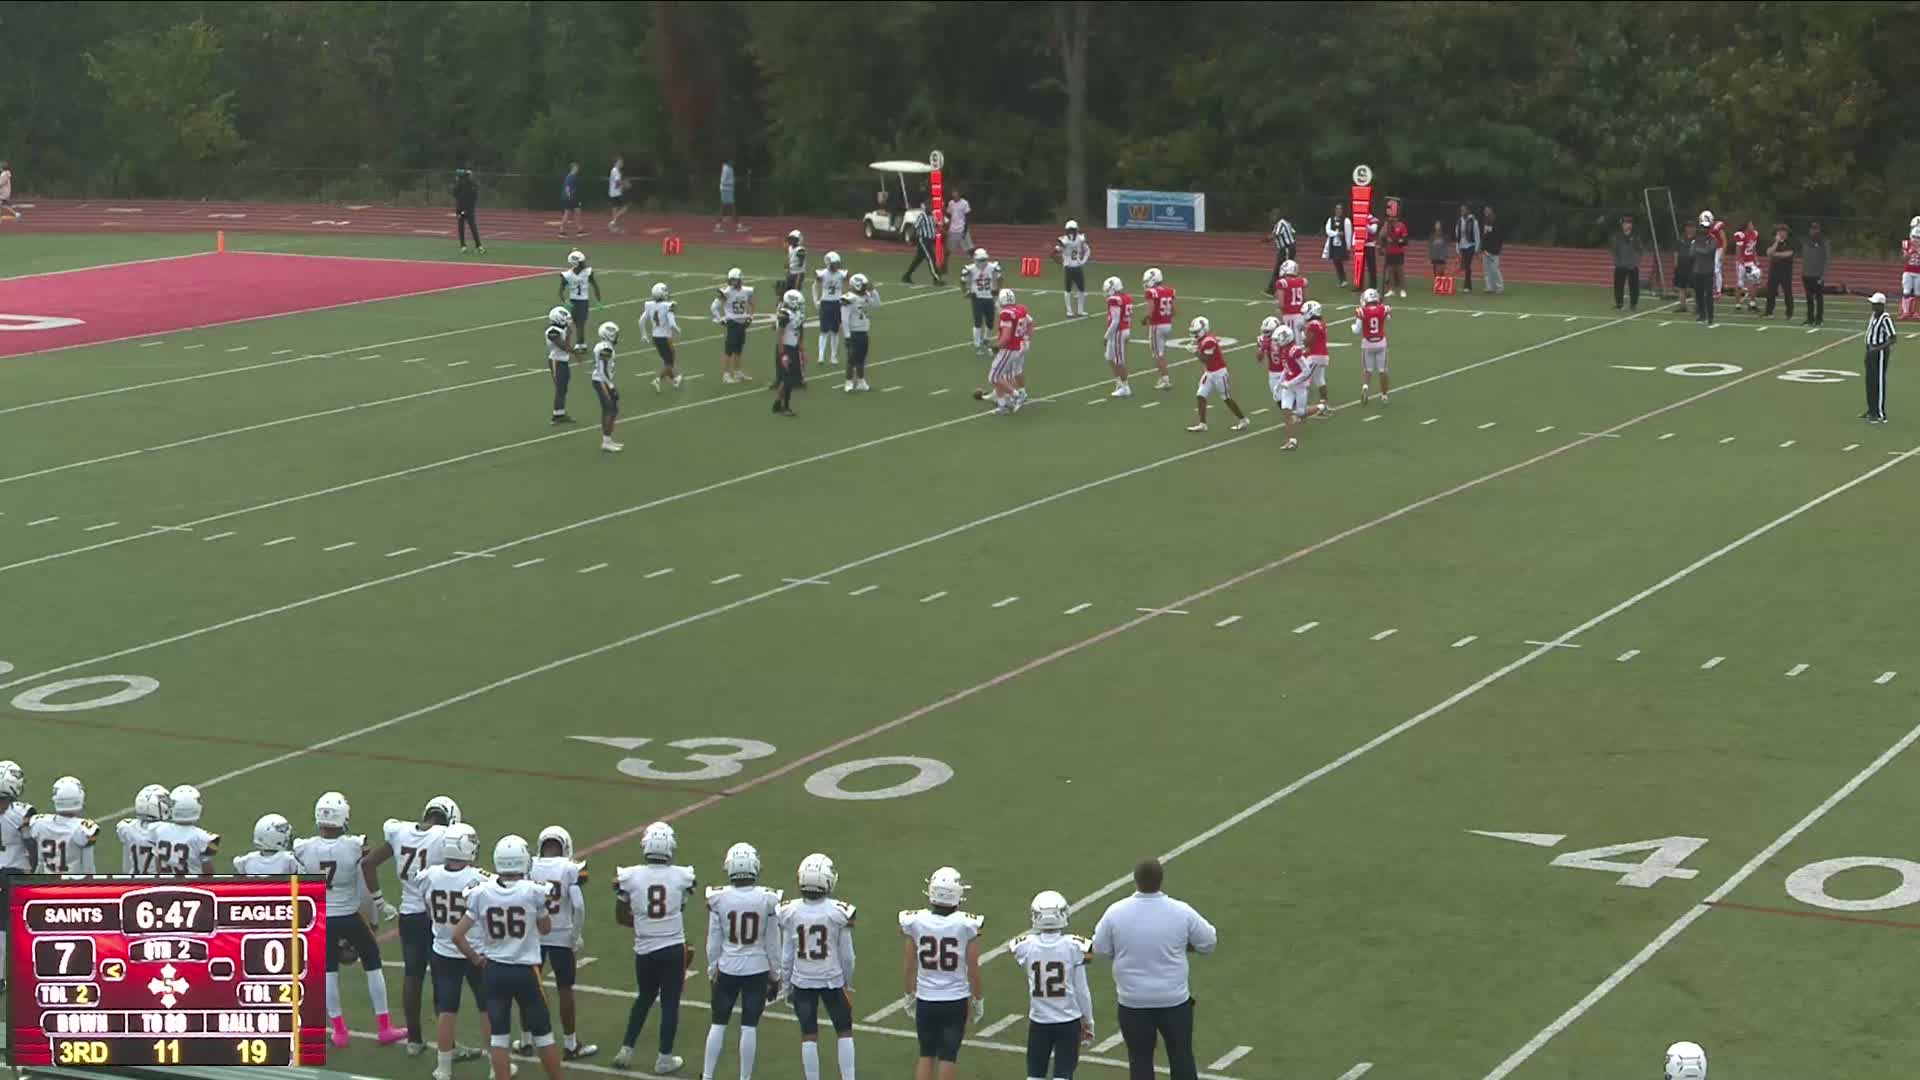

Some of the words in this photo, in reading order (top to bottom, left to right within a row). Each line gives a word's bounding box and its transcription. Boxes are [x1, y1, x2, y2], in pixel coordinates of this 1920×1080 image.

[1434, 277, 1455, 295] 20
[1369, 317, 1379, 334] 9
[41, 839, 68, 873] 21
[130, 843, 156, 875] 17
[157, 841, 190, 874] 23
[400, 846, 427, 880] 71
[319, 860, 337, 891] 7
[431, 889, 465, 925] 65
[647, 884, 667, 919] 8
[486, 906, 525, 940] 66
[726, 911, 760, 945] 10
[796, 924, 829, 960] 13
[919, 936, 959, 971] 26
[1031, 961, 1066, 998] 12
